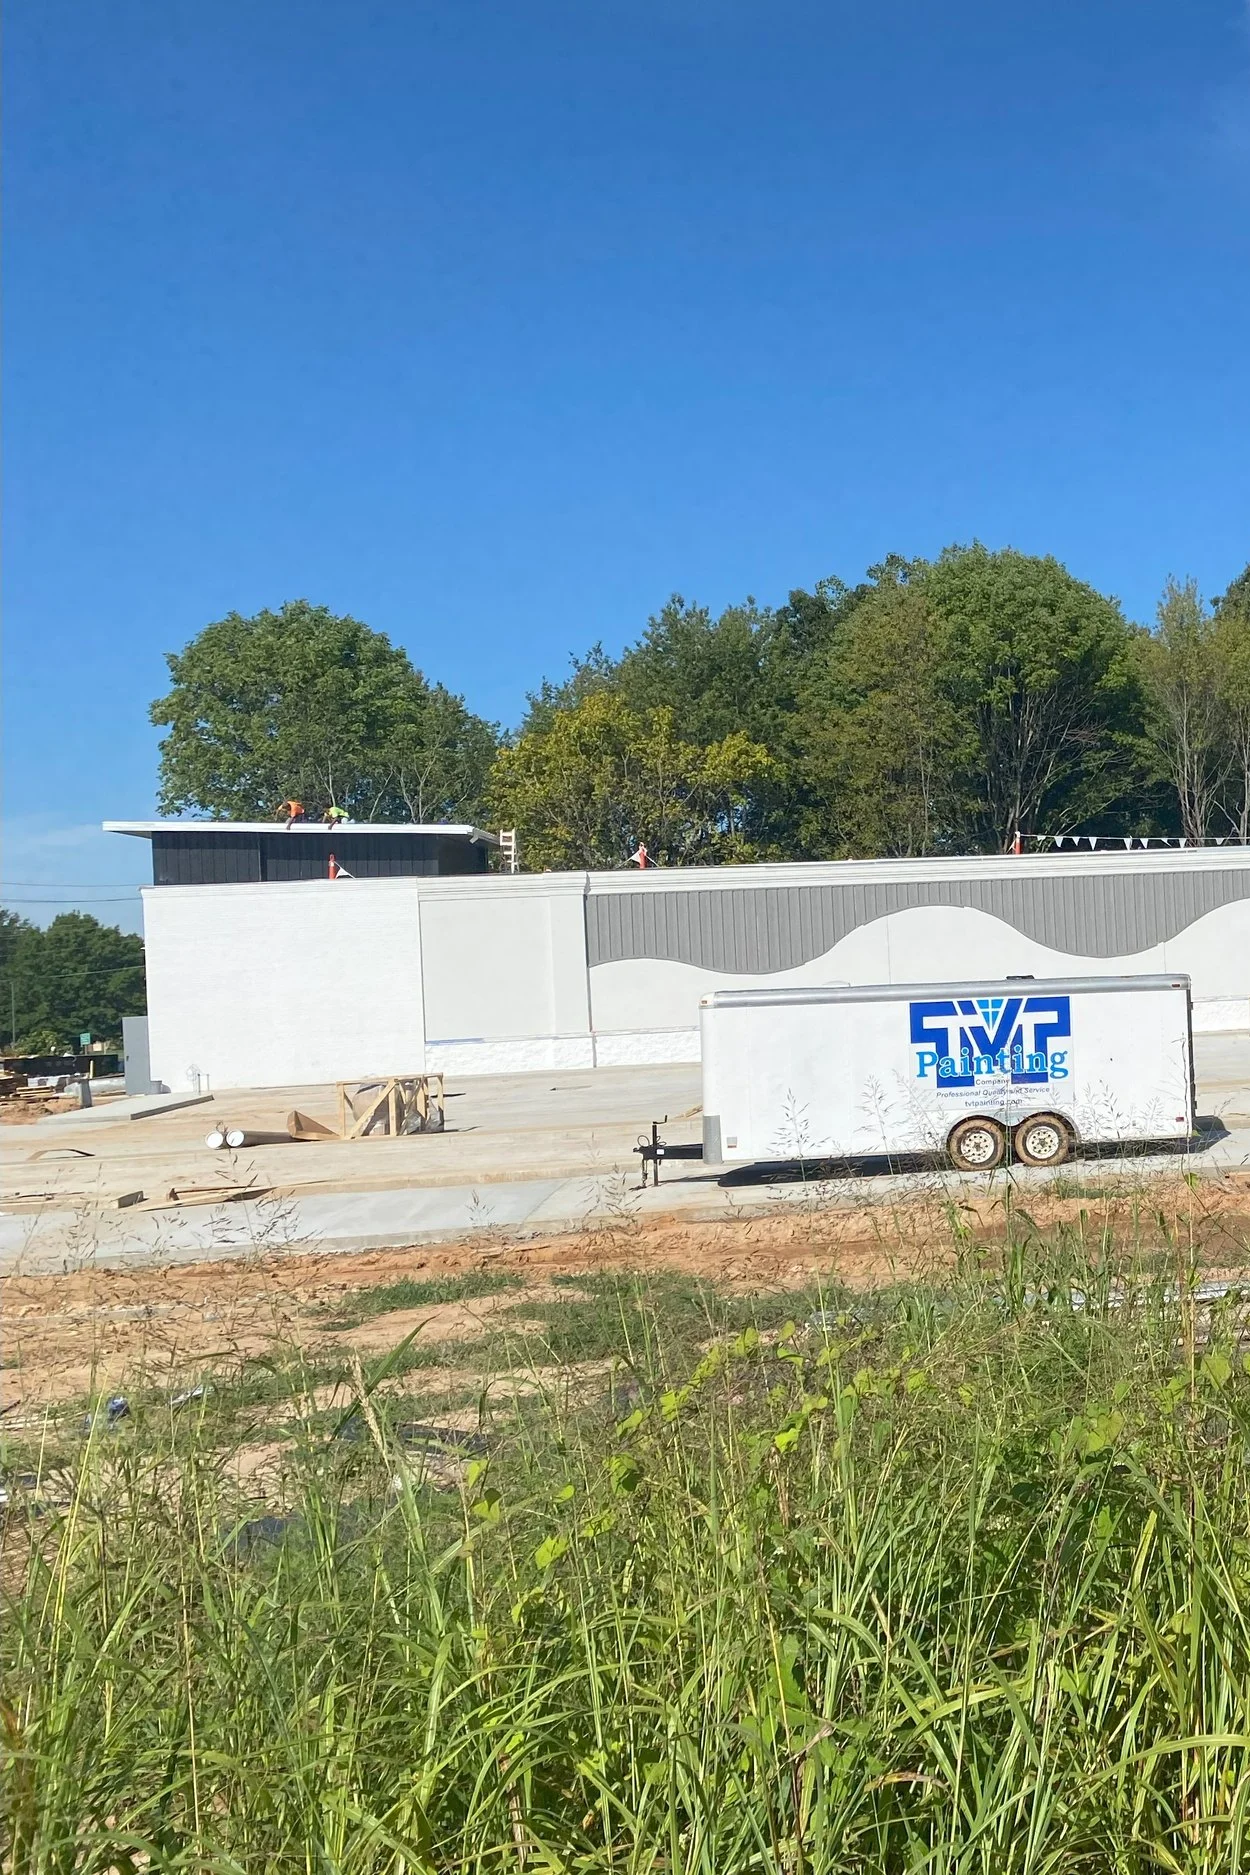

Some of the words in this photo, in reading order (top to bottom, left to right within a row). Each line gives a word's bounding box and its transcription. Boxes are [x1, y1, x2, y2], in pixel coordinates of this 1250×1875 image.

[910, 996, 1071, 1088] TVT
[916, 1045, 1069, 1079] Painting
[982, 1088, 1007, 1096] Quality
[965, 1099, 1023, 1107] tvtpainting.com
